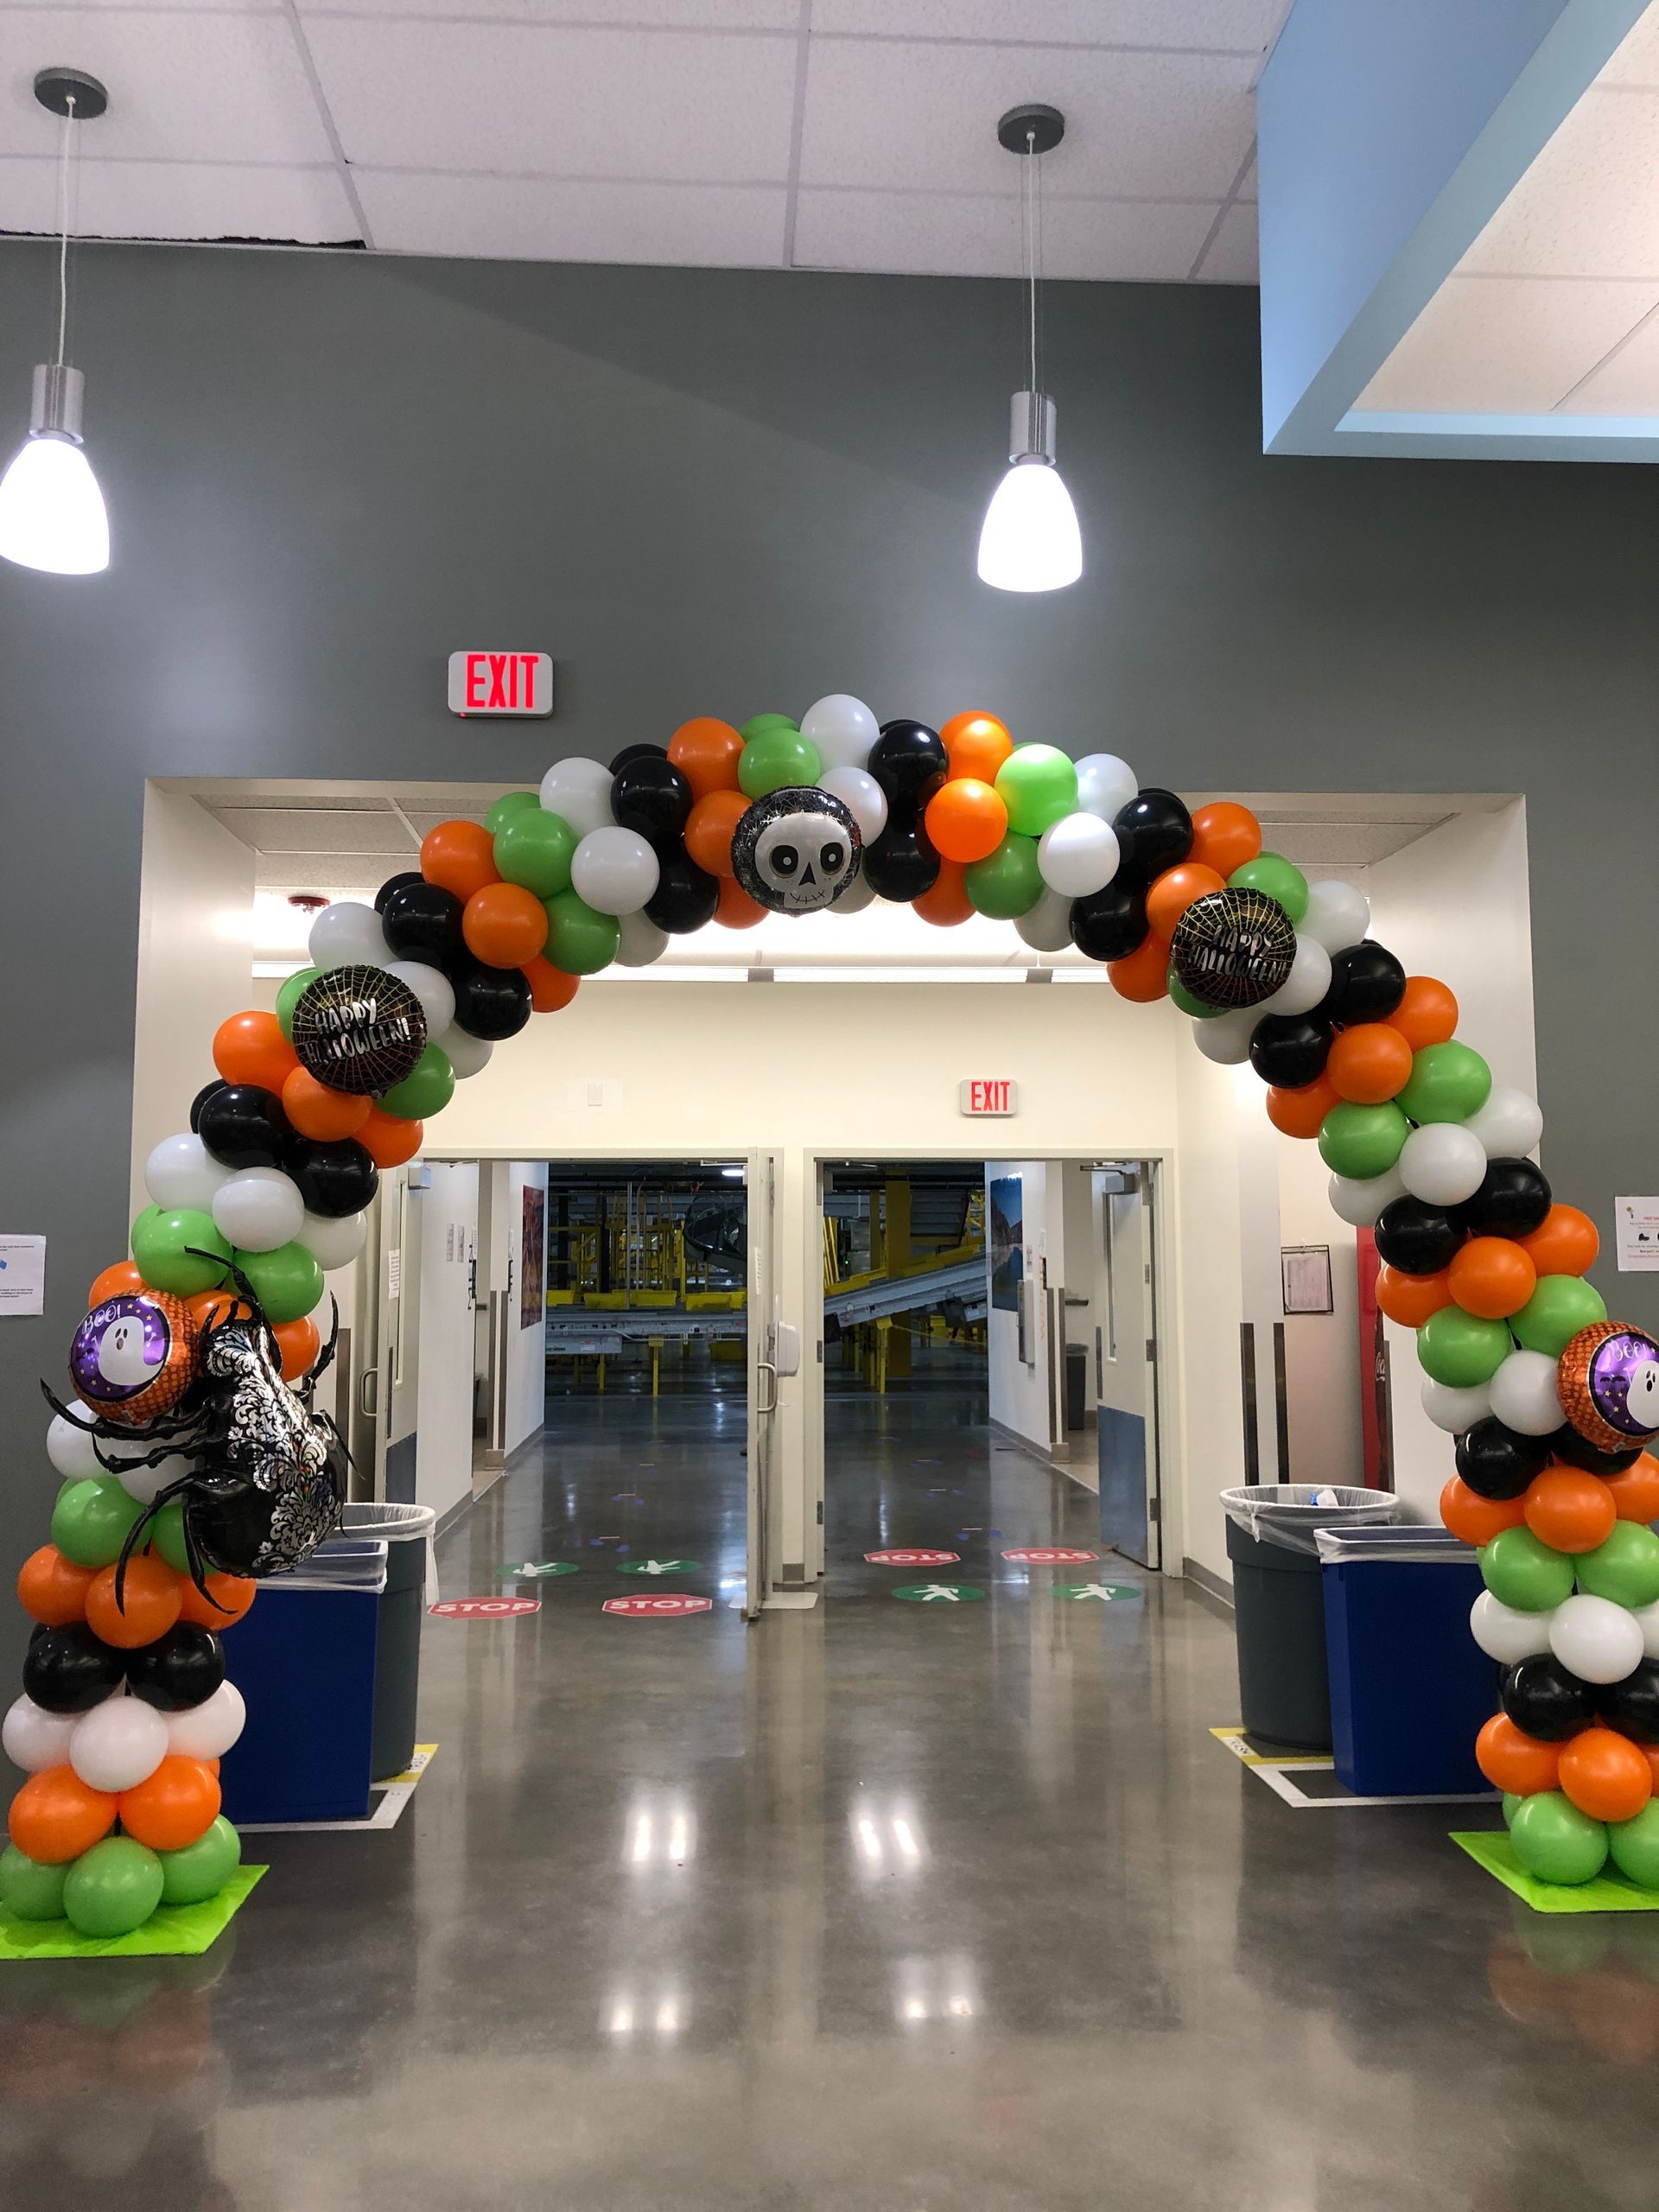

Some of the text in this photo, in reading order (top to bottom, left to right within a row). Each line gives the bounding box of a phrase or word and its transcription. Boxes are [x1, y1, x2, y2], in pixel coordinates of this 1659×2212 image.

[467, 654, 539, 709] EXIT
[1212, 925, 1275, 957] HAPPY
[314, 997, 377, 1035] HAPPY
[971, 1081, 1010, 1111] EXIT
[81, 1303, 122, 1335] BOO!
[871, 1553, 954, 1562] STOP
[1009, 1552, 1091, 1560] STOP
[435, 1601, 535, 1613] STOP
[608, 1599, 707, 1611] STOP
